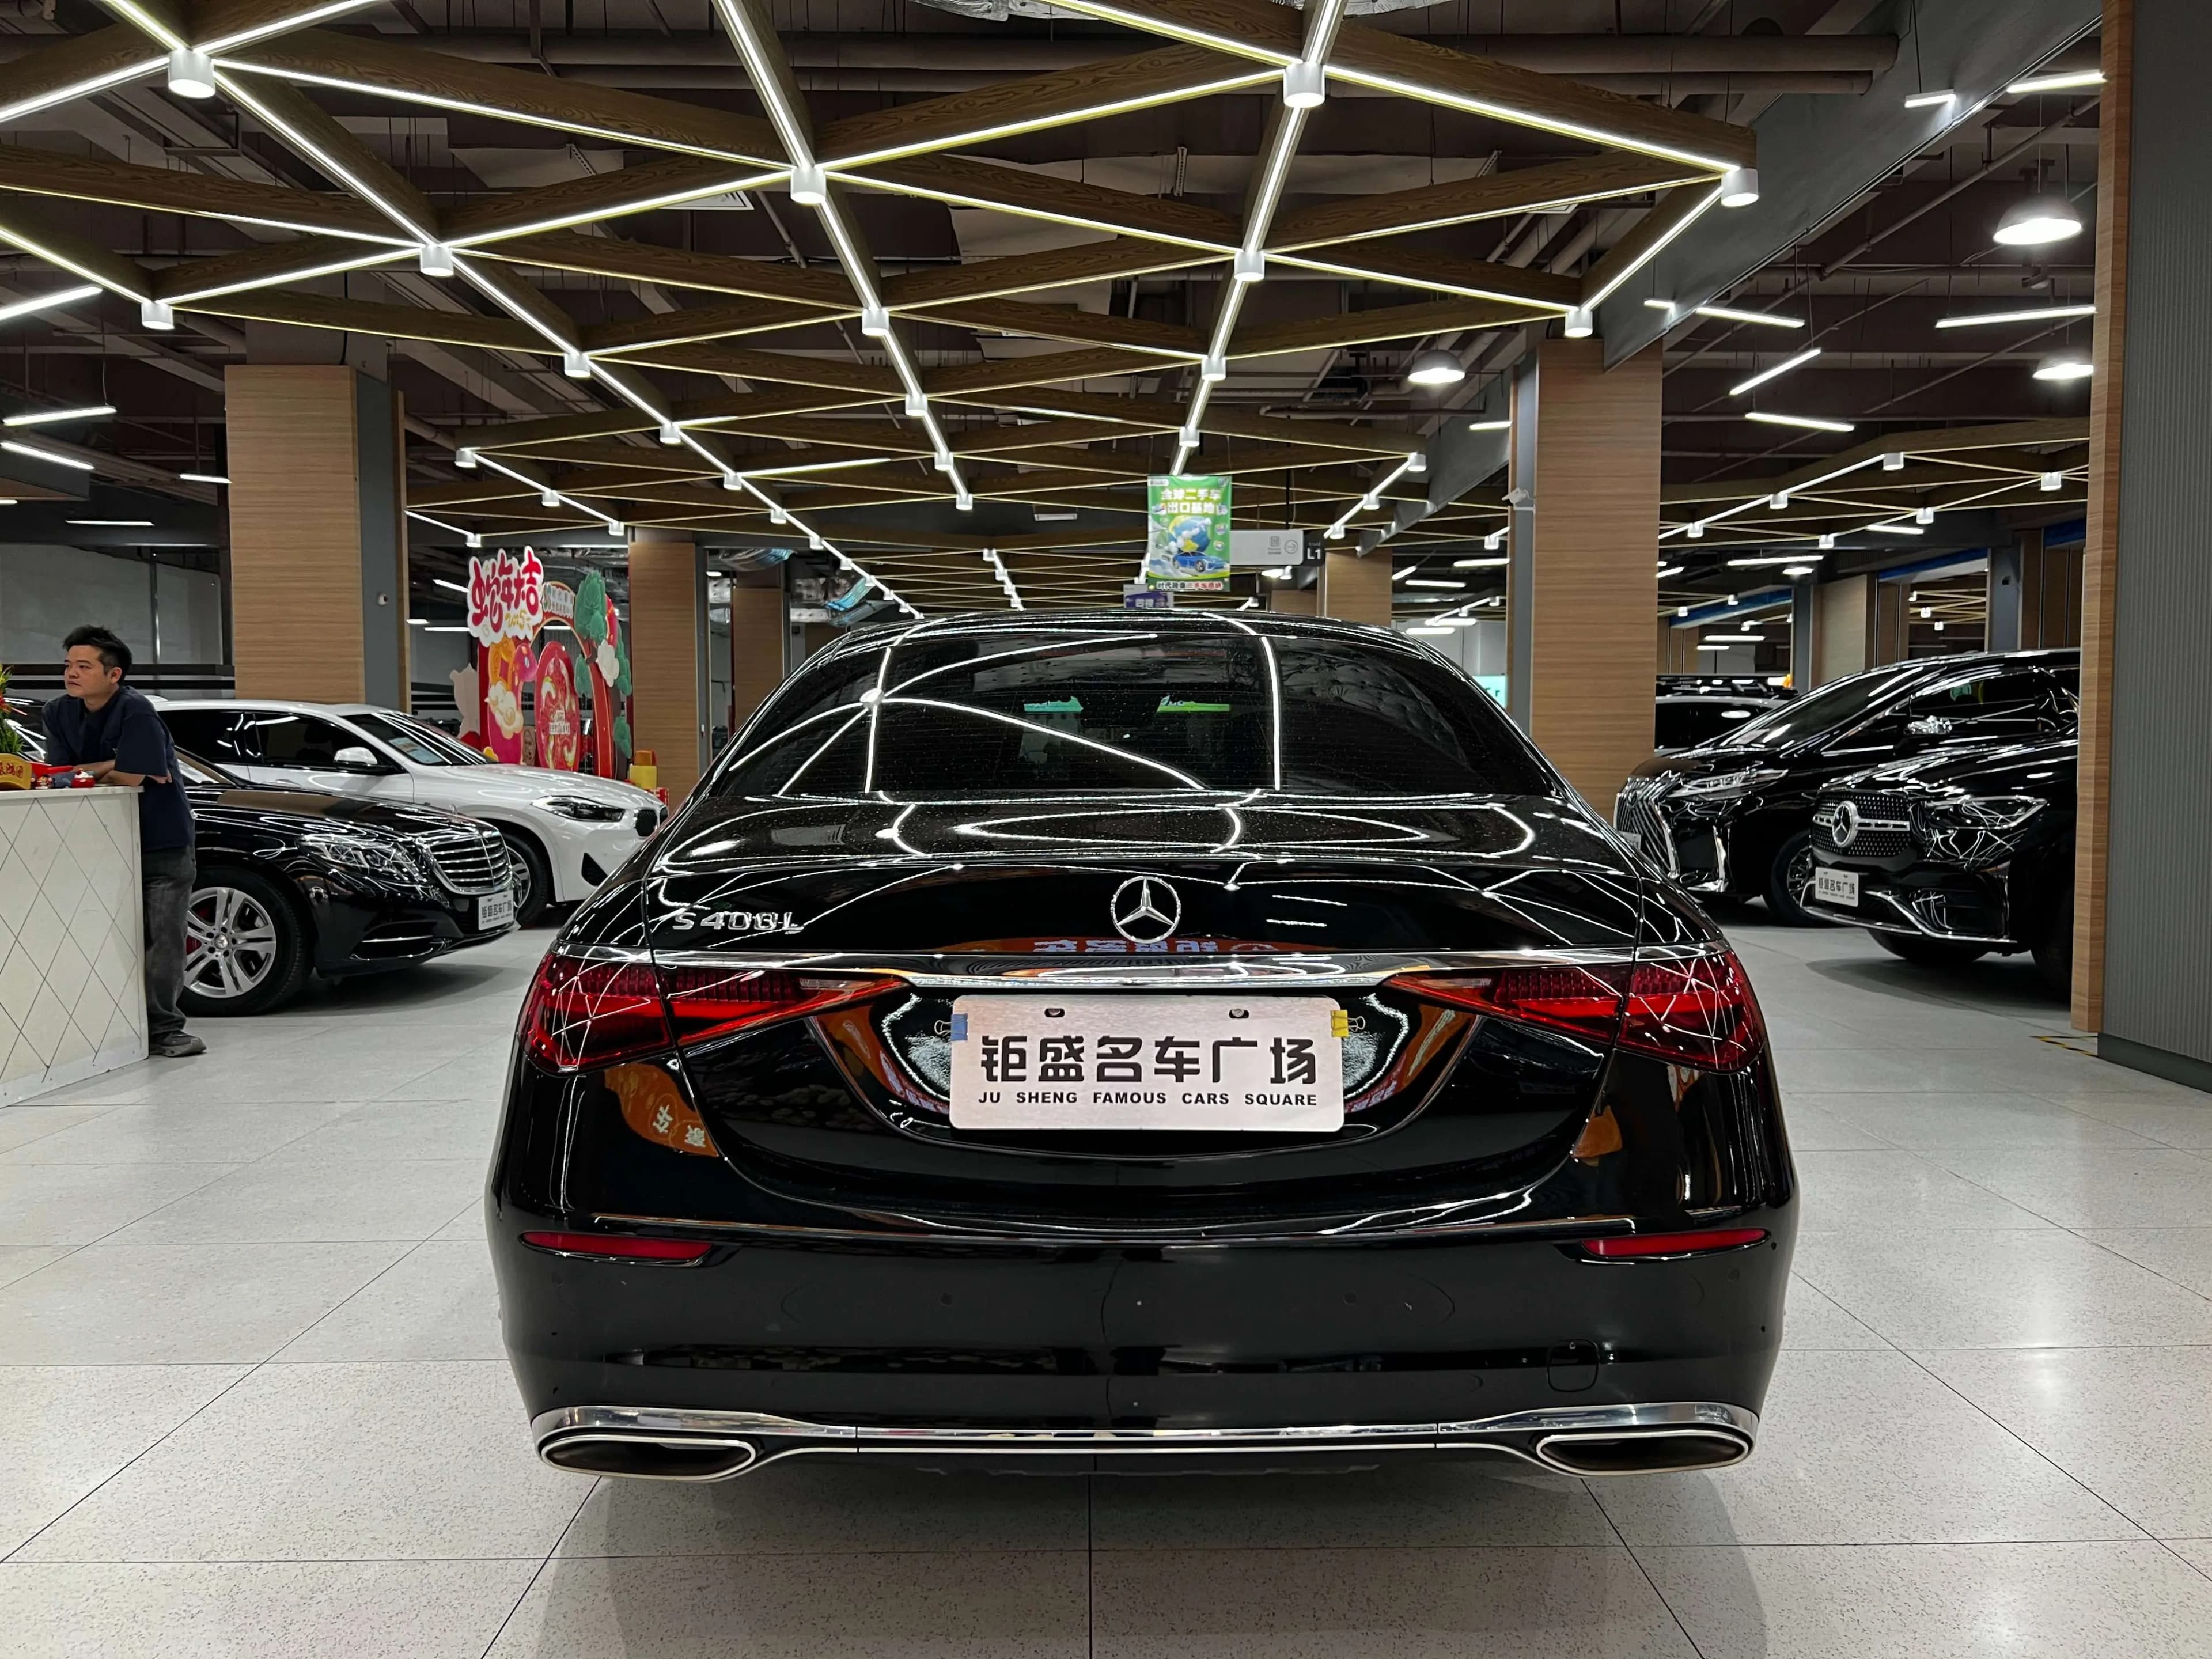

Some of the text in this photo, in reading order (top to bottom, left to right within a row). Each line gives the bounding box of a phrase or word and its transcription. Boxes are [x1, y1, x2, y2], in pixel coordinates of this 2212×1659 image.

[1307, 548, 1320, 559] L1
[981, 1036, 1315, 1084] 钜盛名车广场
[979, 1092, 1316, 1105] JU SHENG FAMOUS CARS SQUARE
